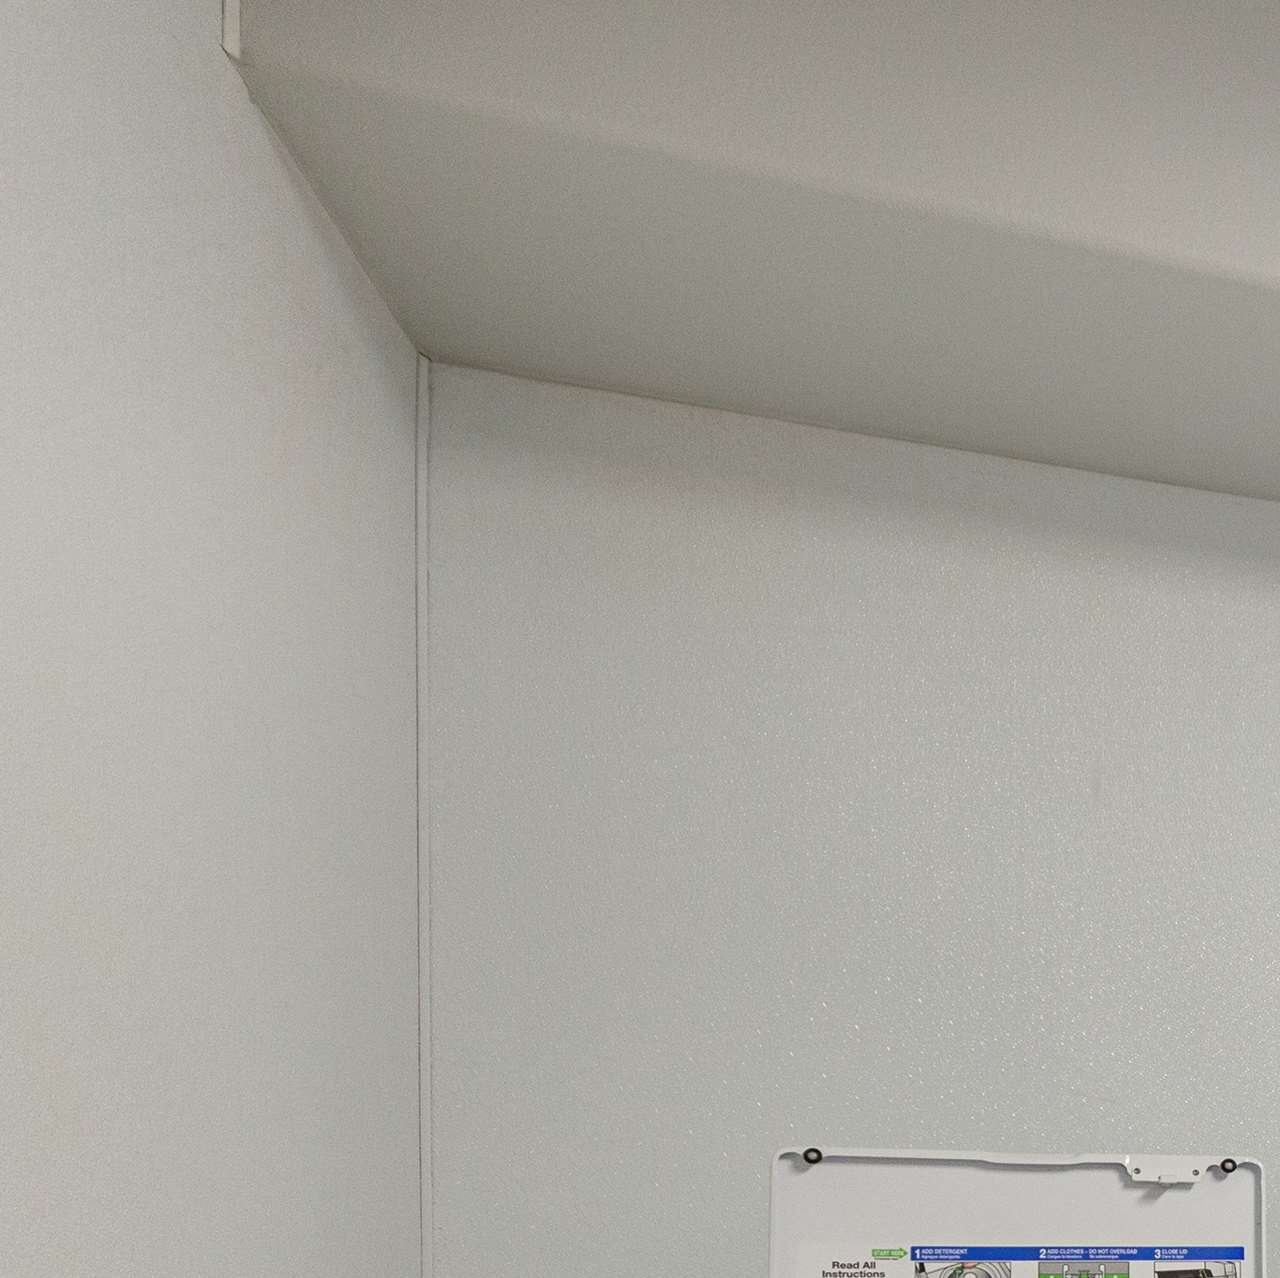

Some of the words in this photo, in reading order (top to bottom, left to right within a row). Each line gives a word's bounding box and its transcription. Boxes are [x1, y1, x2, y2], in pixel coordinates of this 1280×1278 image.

[914, 1249, 921, 1259] 1
[1039, 1249, 1047, 1259] 2
[1154, 1249, 1161, 1259] 3
[832, 1261, 860, 1269] Read
[862, 1261, 876, 1269] All
[822, 1270, 885, 1278] Instructions
